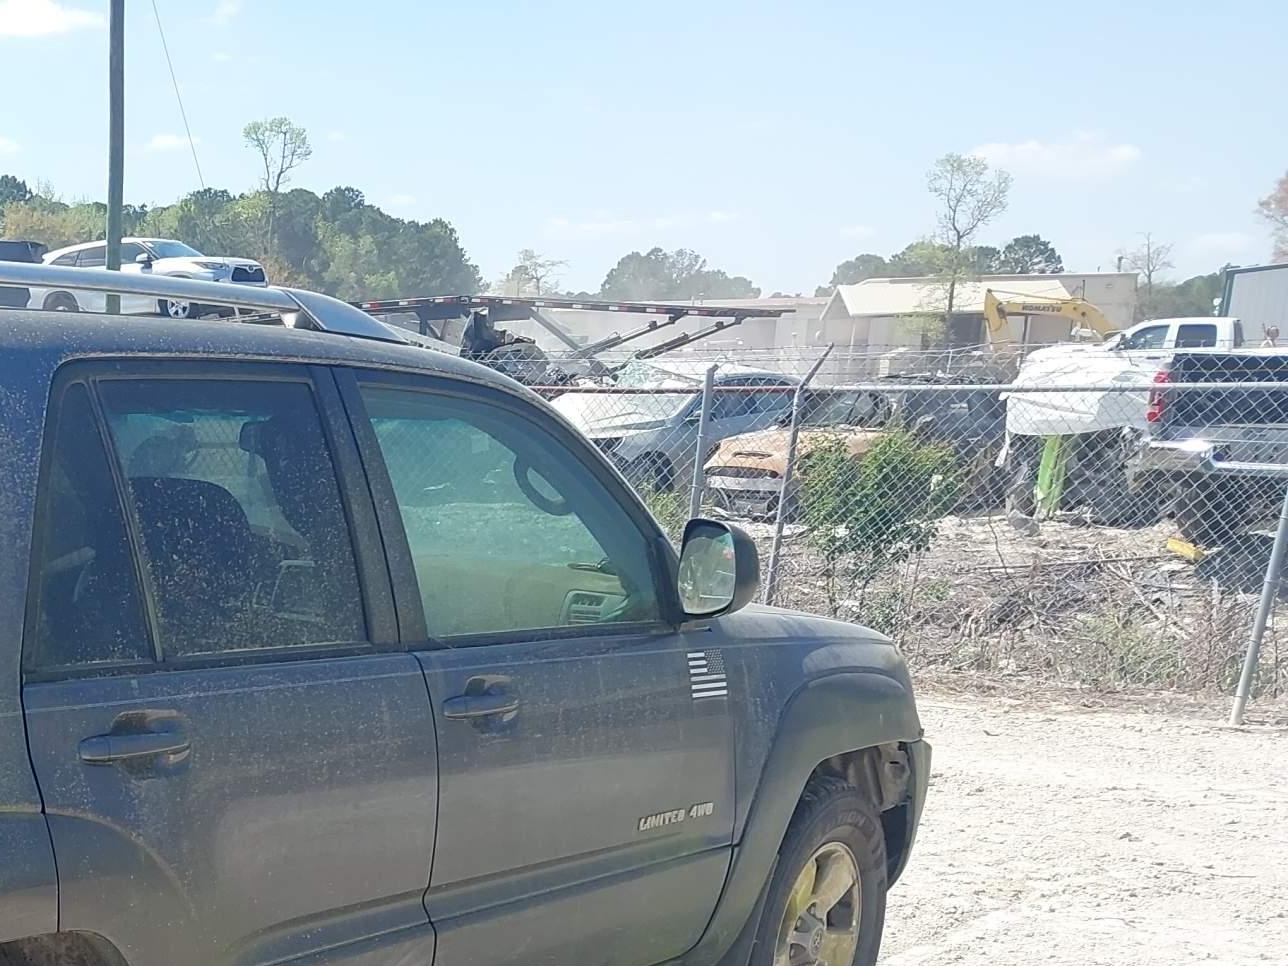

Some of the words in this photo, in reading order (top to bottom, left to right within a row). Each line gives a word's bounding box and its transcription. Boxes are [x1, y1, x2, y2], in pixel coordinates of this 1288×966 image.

[1022, 303, 1063, 313] KOMATSU
[638, 808, 686, 832] LIMITED
[689, 801, 714, 819] 4WD
